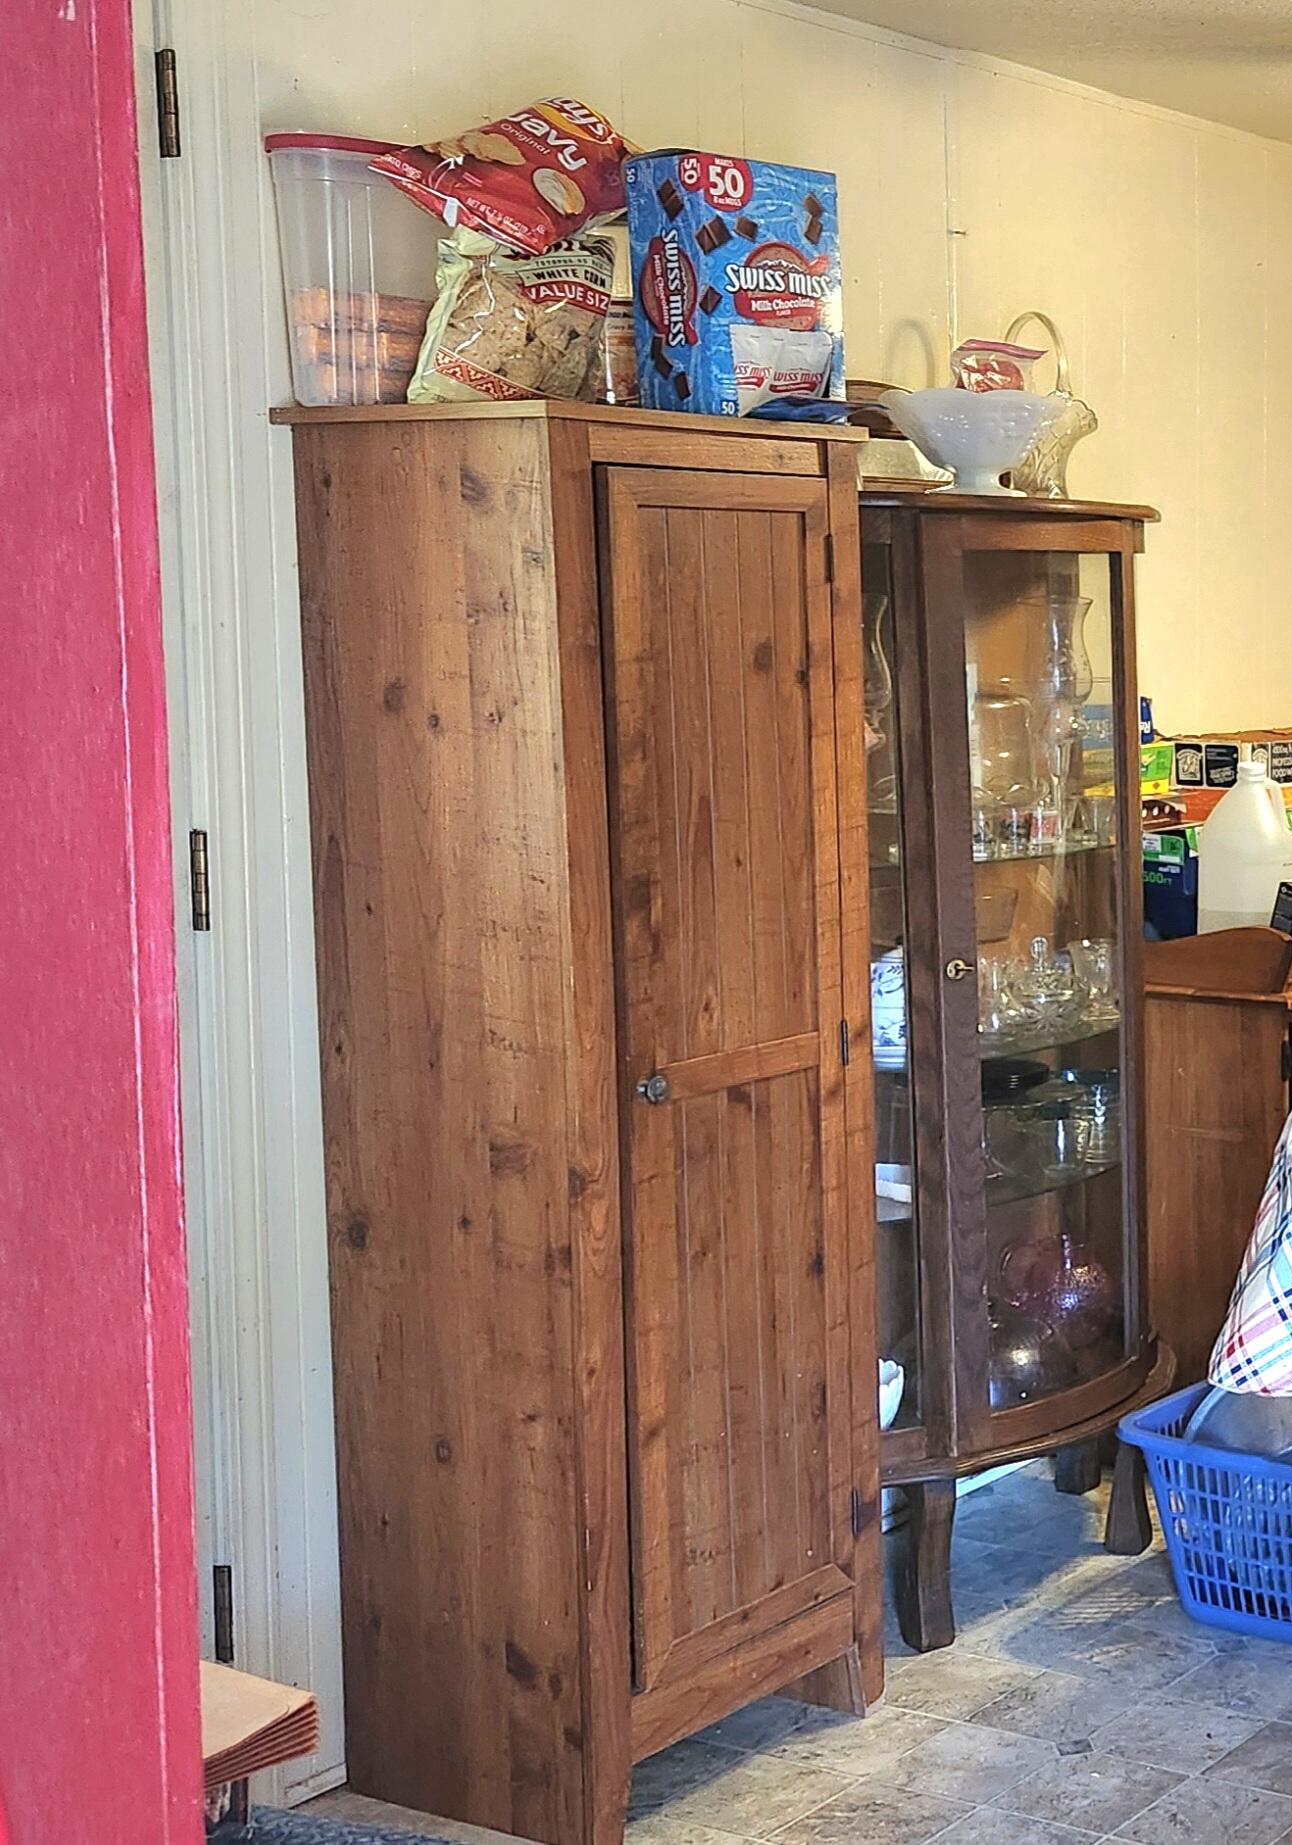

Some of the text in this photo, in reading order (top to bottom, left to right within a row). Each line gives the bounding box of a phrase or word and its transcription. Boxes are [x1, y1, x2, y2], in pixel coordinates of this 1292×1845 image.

[500, 123, 551, 155] Original
[683, 157, 698, 185] 50
[708, 165, 745, 198] 50
[533, 268, 606, 289] WHITE CORN
[725, 263, 786, 293] SWISS
[527, 283, 610, 310] VALUE SIZ
[751, 297, 816, 312] Milk Chocolate
[721, 401, 735, 415] 50
